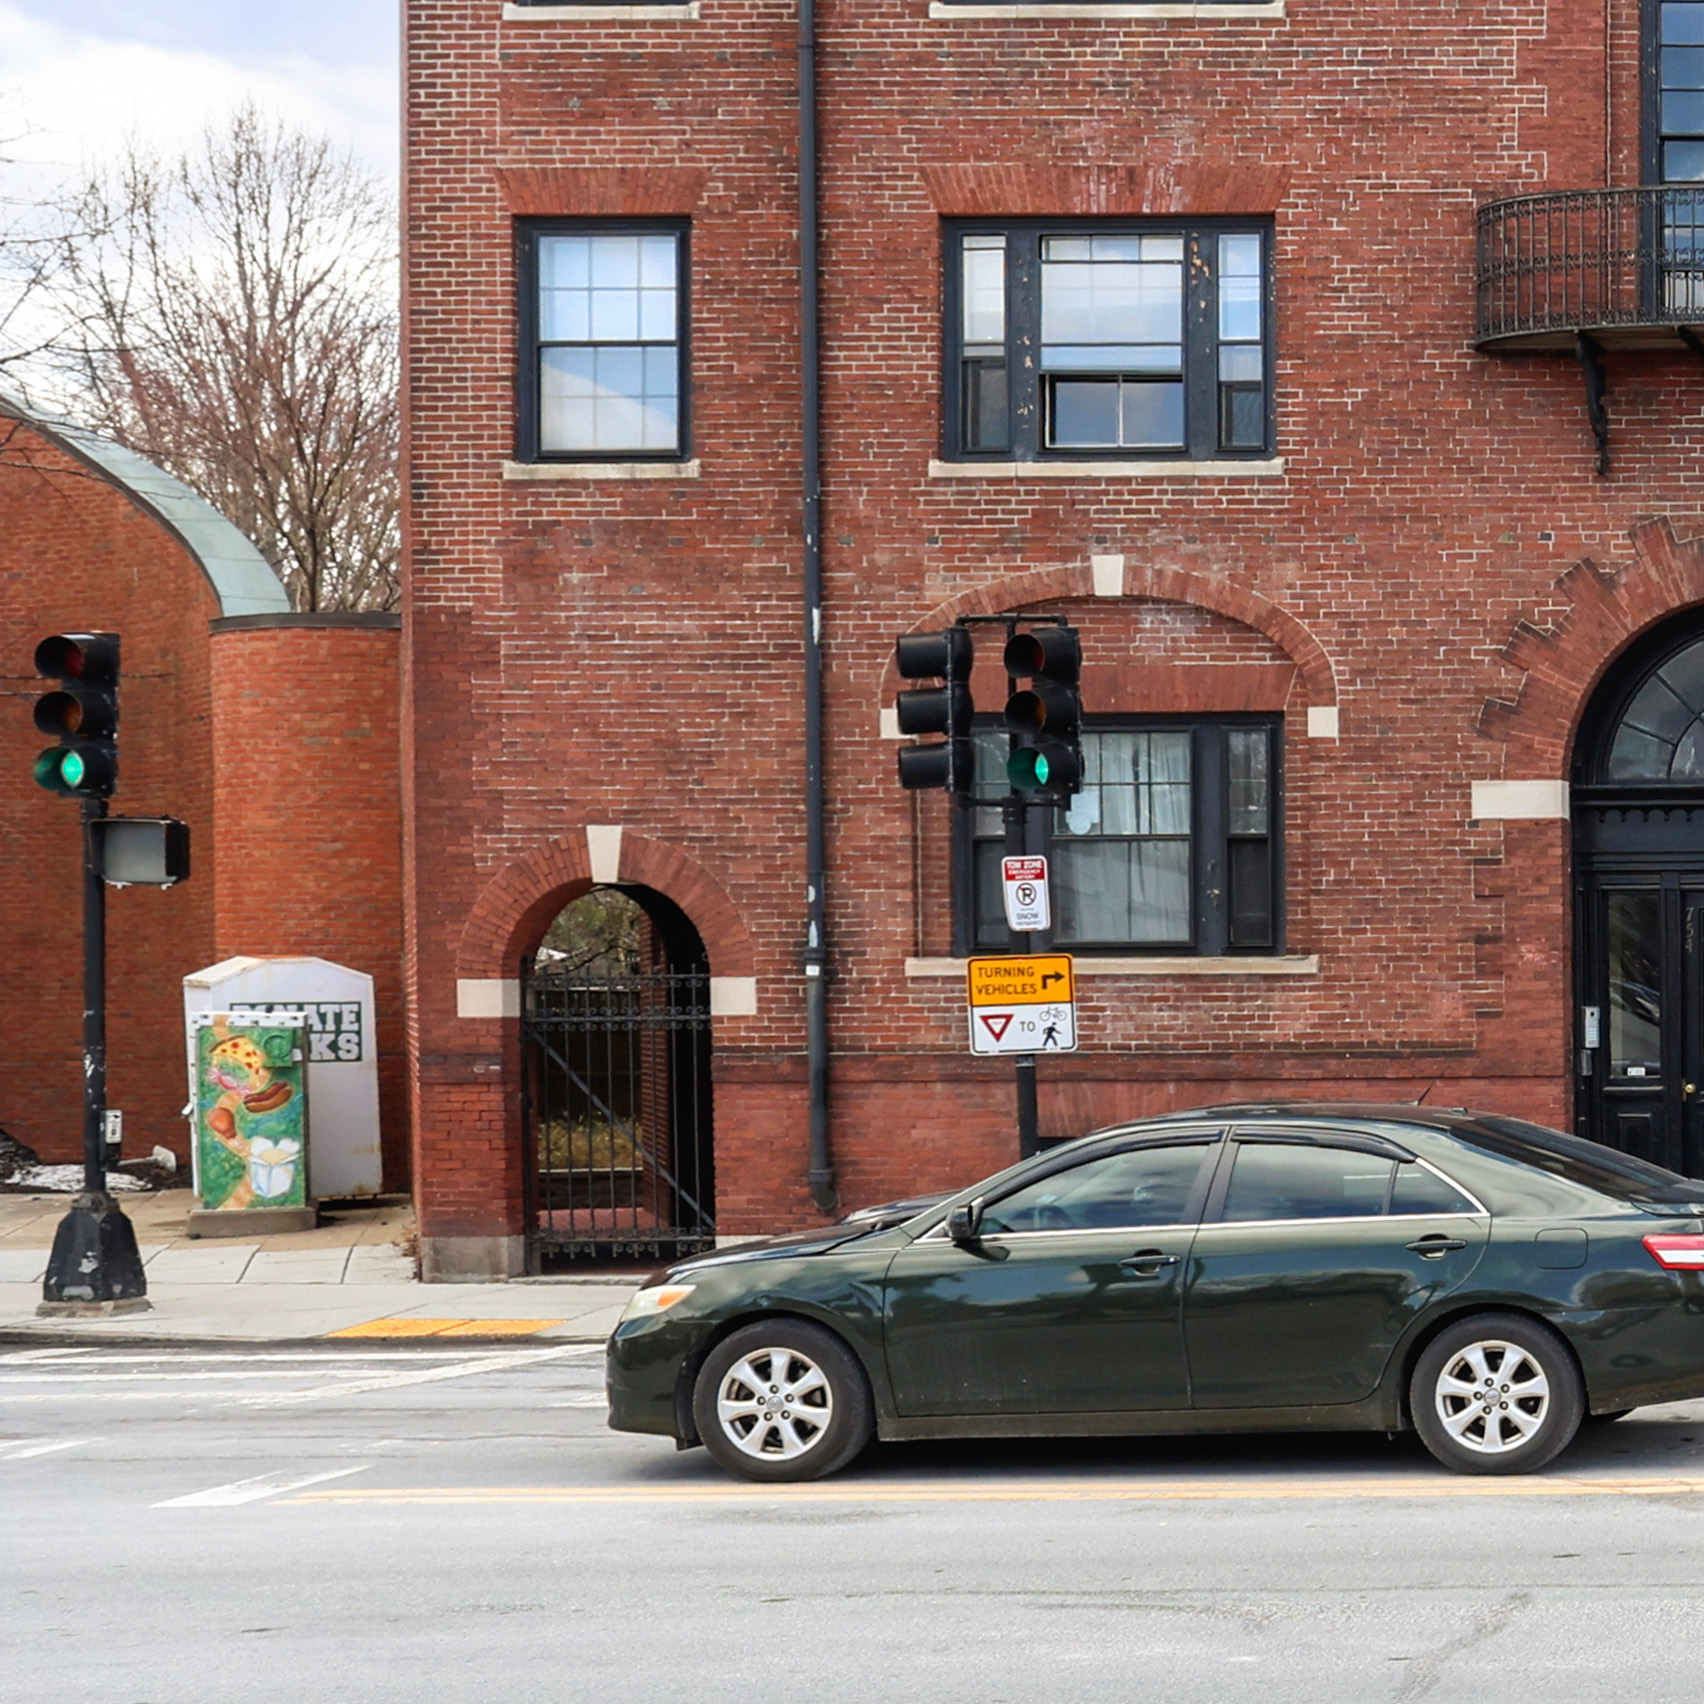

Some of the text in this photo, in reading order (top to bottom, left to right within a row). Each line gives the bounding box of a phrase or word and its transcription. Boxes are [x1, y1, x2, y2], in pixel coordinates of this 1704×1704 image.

[1023, 860, 1042, 869] ZONE
[978, 966, 1035, 978] TURNING
[976, 983, 1038, 995] VEHICLES
[1019, 1021, 1036, 1032] TO
